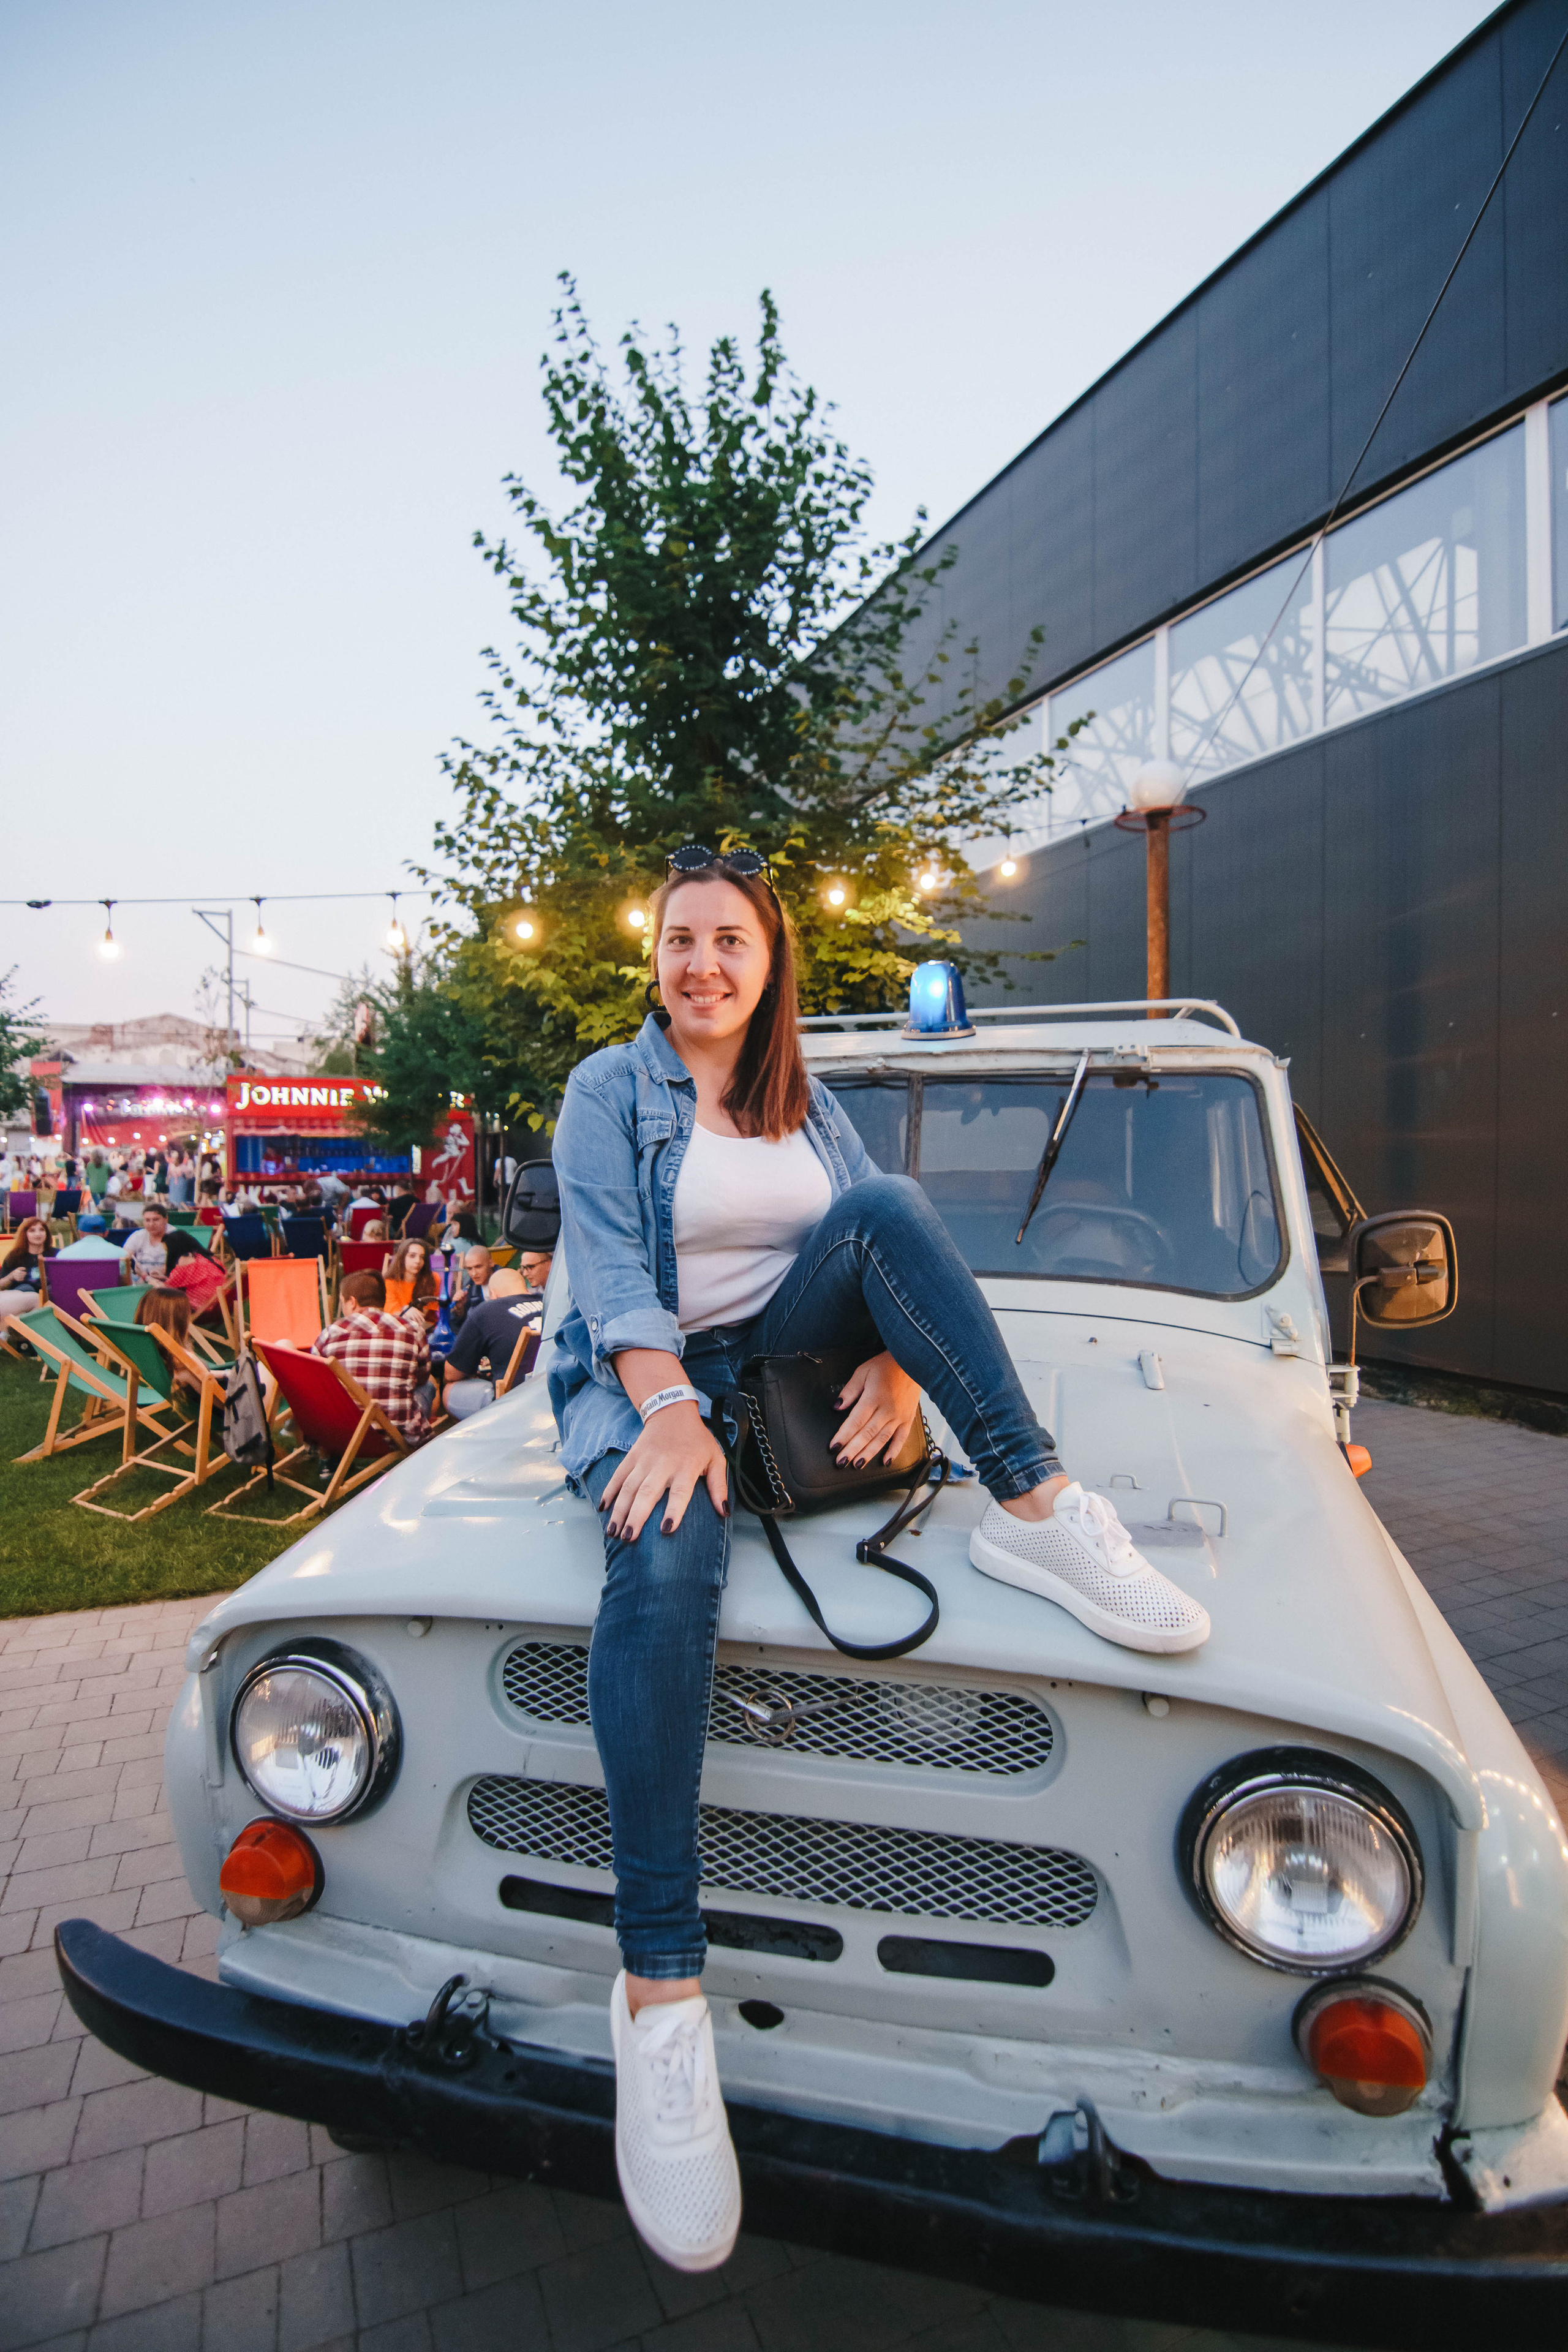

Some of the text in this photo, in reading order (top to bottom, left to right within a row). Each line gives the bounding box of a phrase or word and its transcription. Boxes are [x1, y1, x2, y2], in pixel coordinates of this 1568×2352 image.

[235, 1082, 355, 1110] JOHNNIE
[641, 1390, 684, 1419] Captain Morgan
